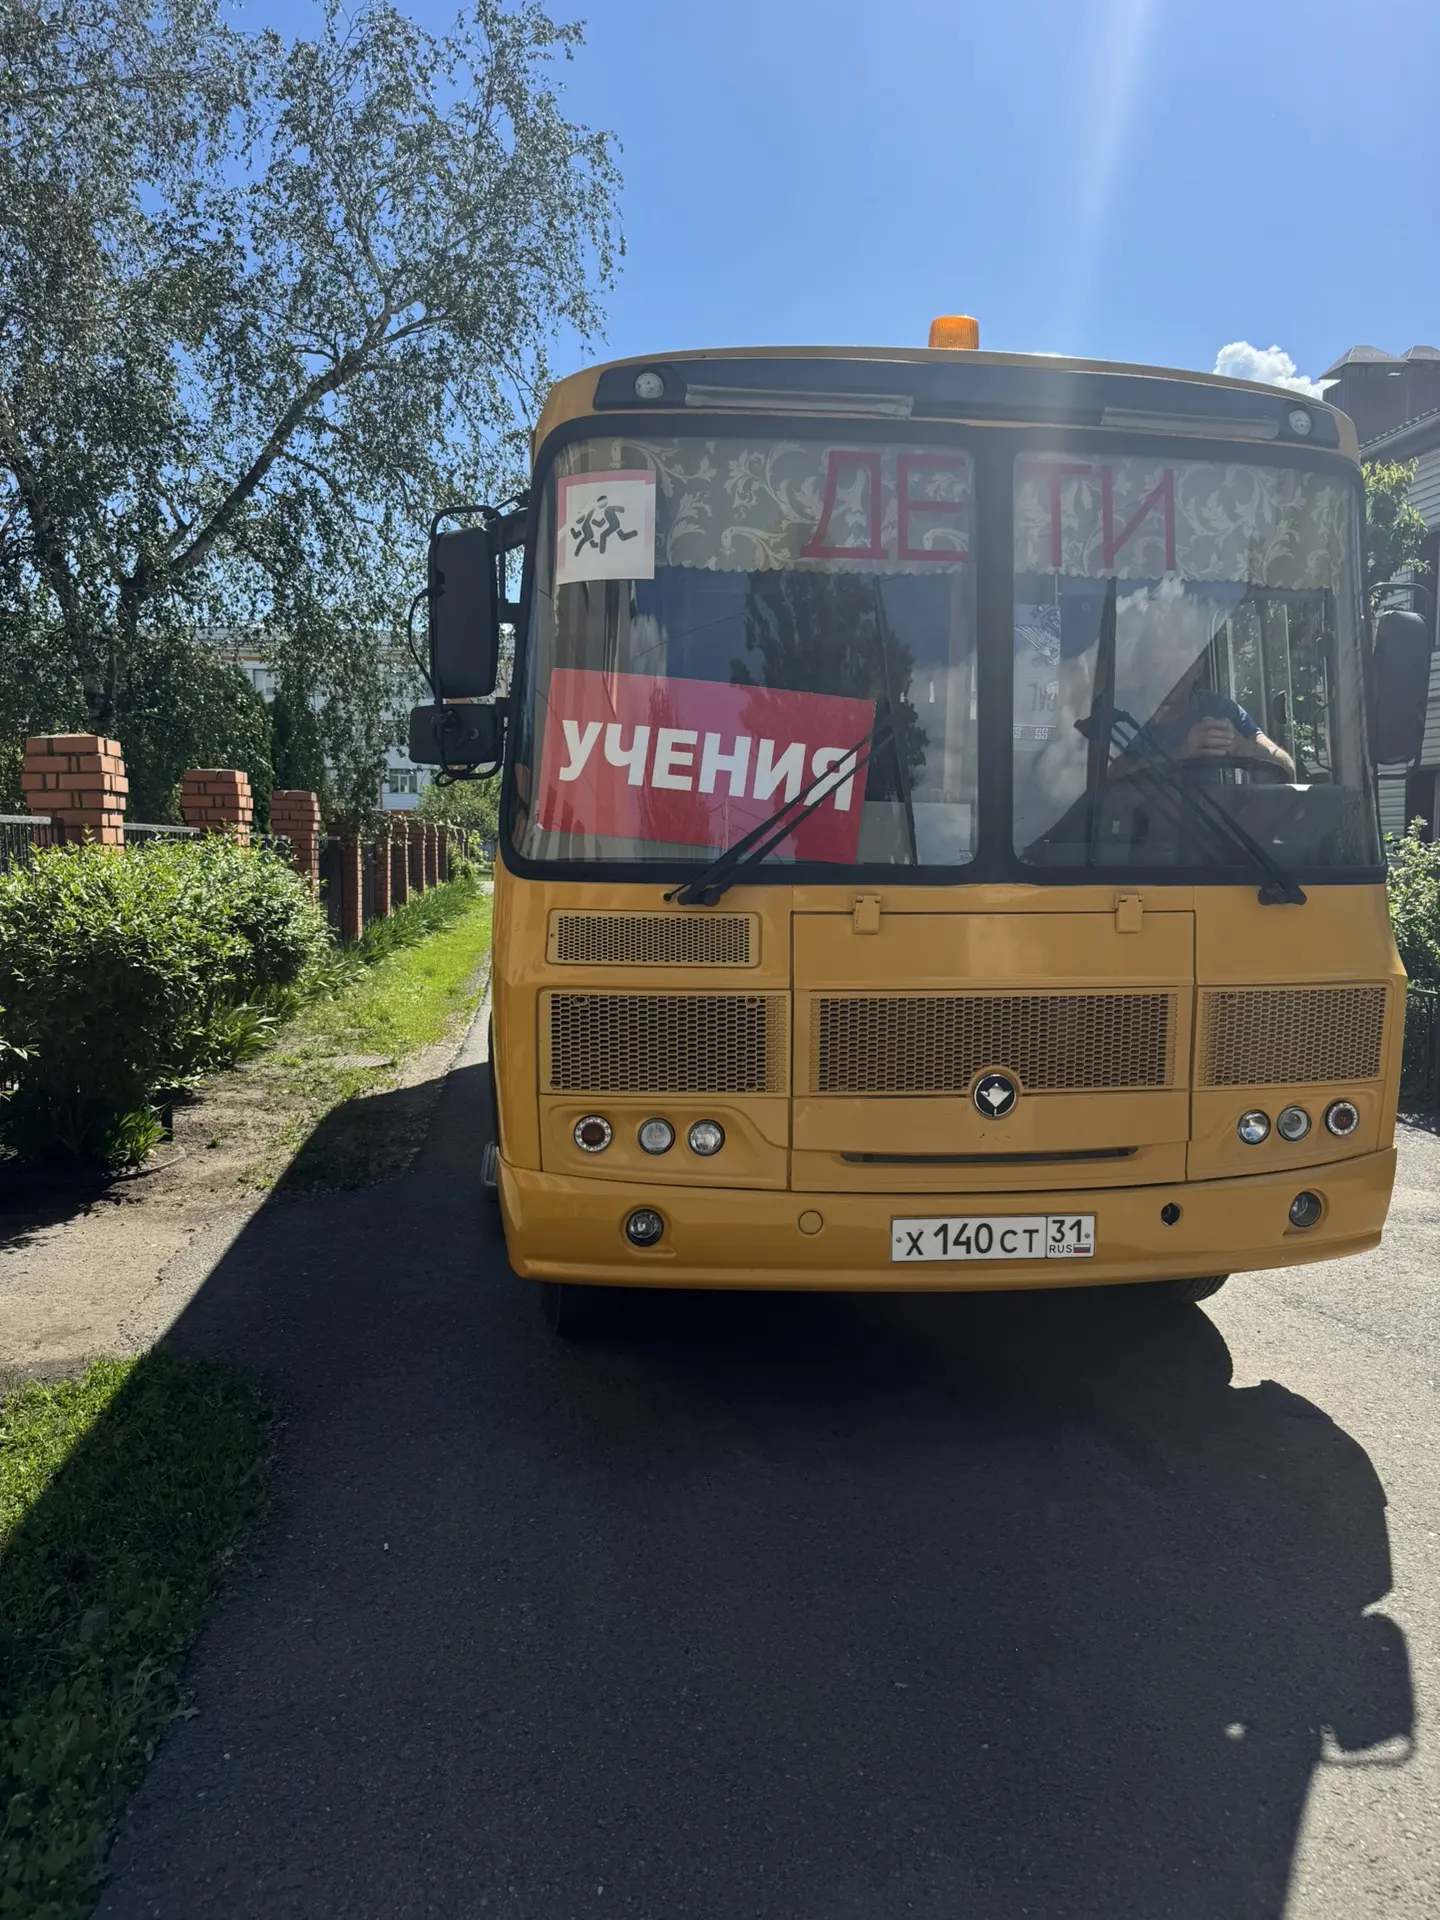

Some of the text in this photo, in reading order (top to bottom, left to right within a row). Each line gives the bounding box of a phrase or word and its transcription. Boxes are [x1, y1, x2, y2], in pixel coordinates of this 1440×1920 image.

[559, 719, 857, 812] УЧЕНИЯ
[1051, 1219, 1082, 1243] 31
[1049, 1244, 1072, 1254] RUS
